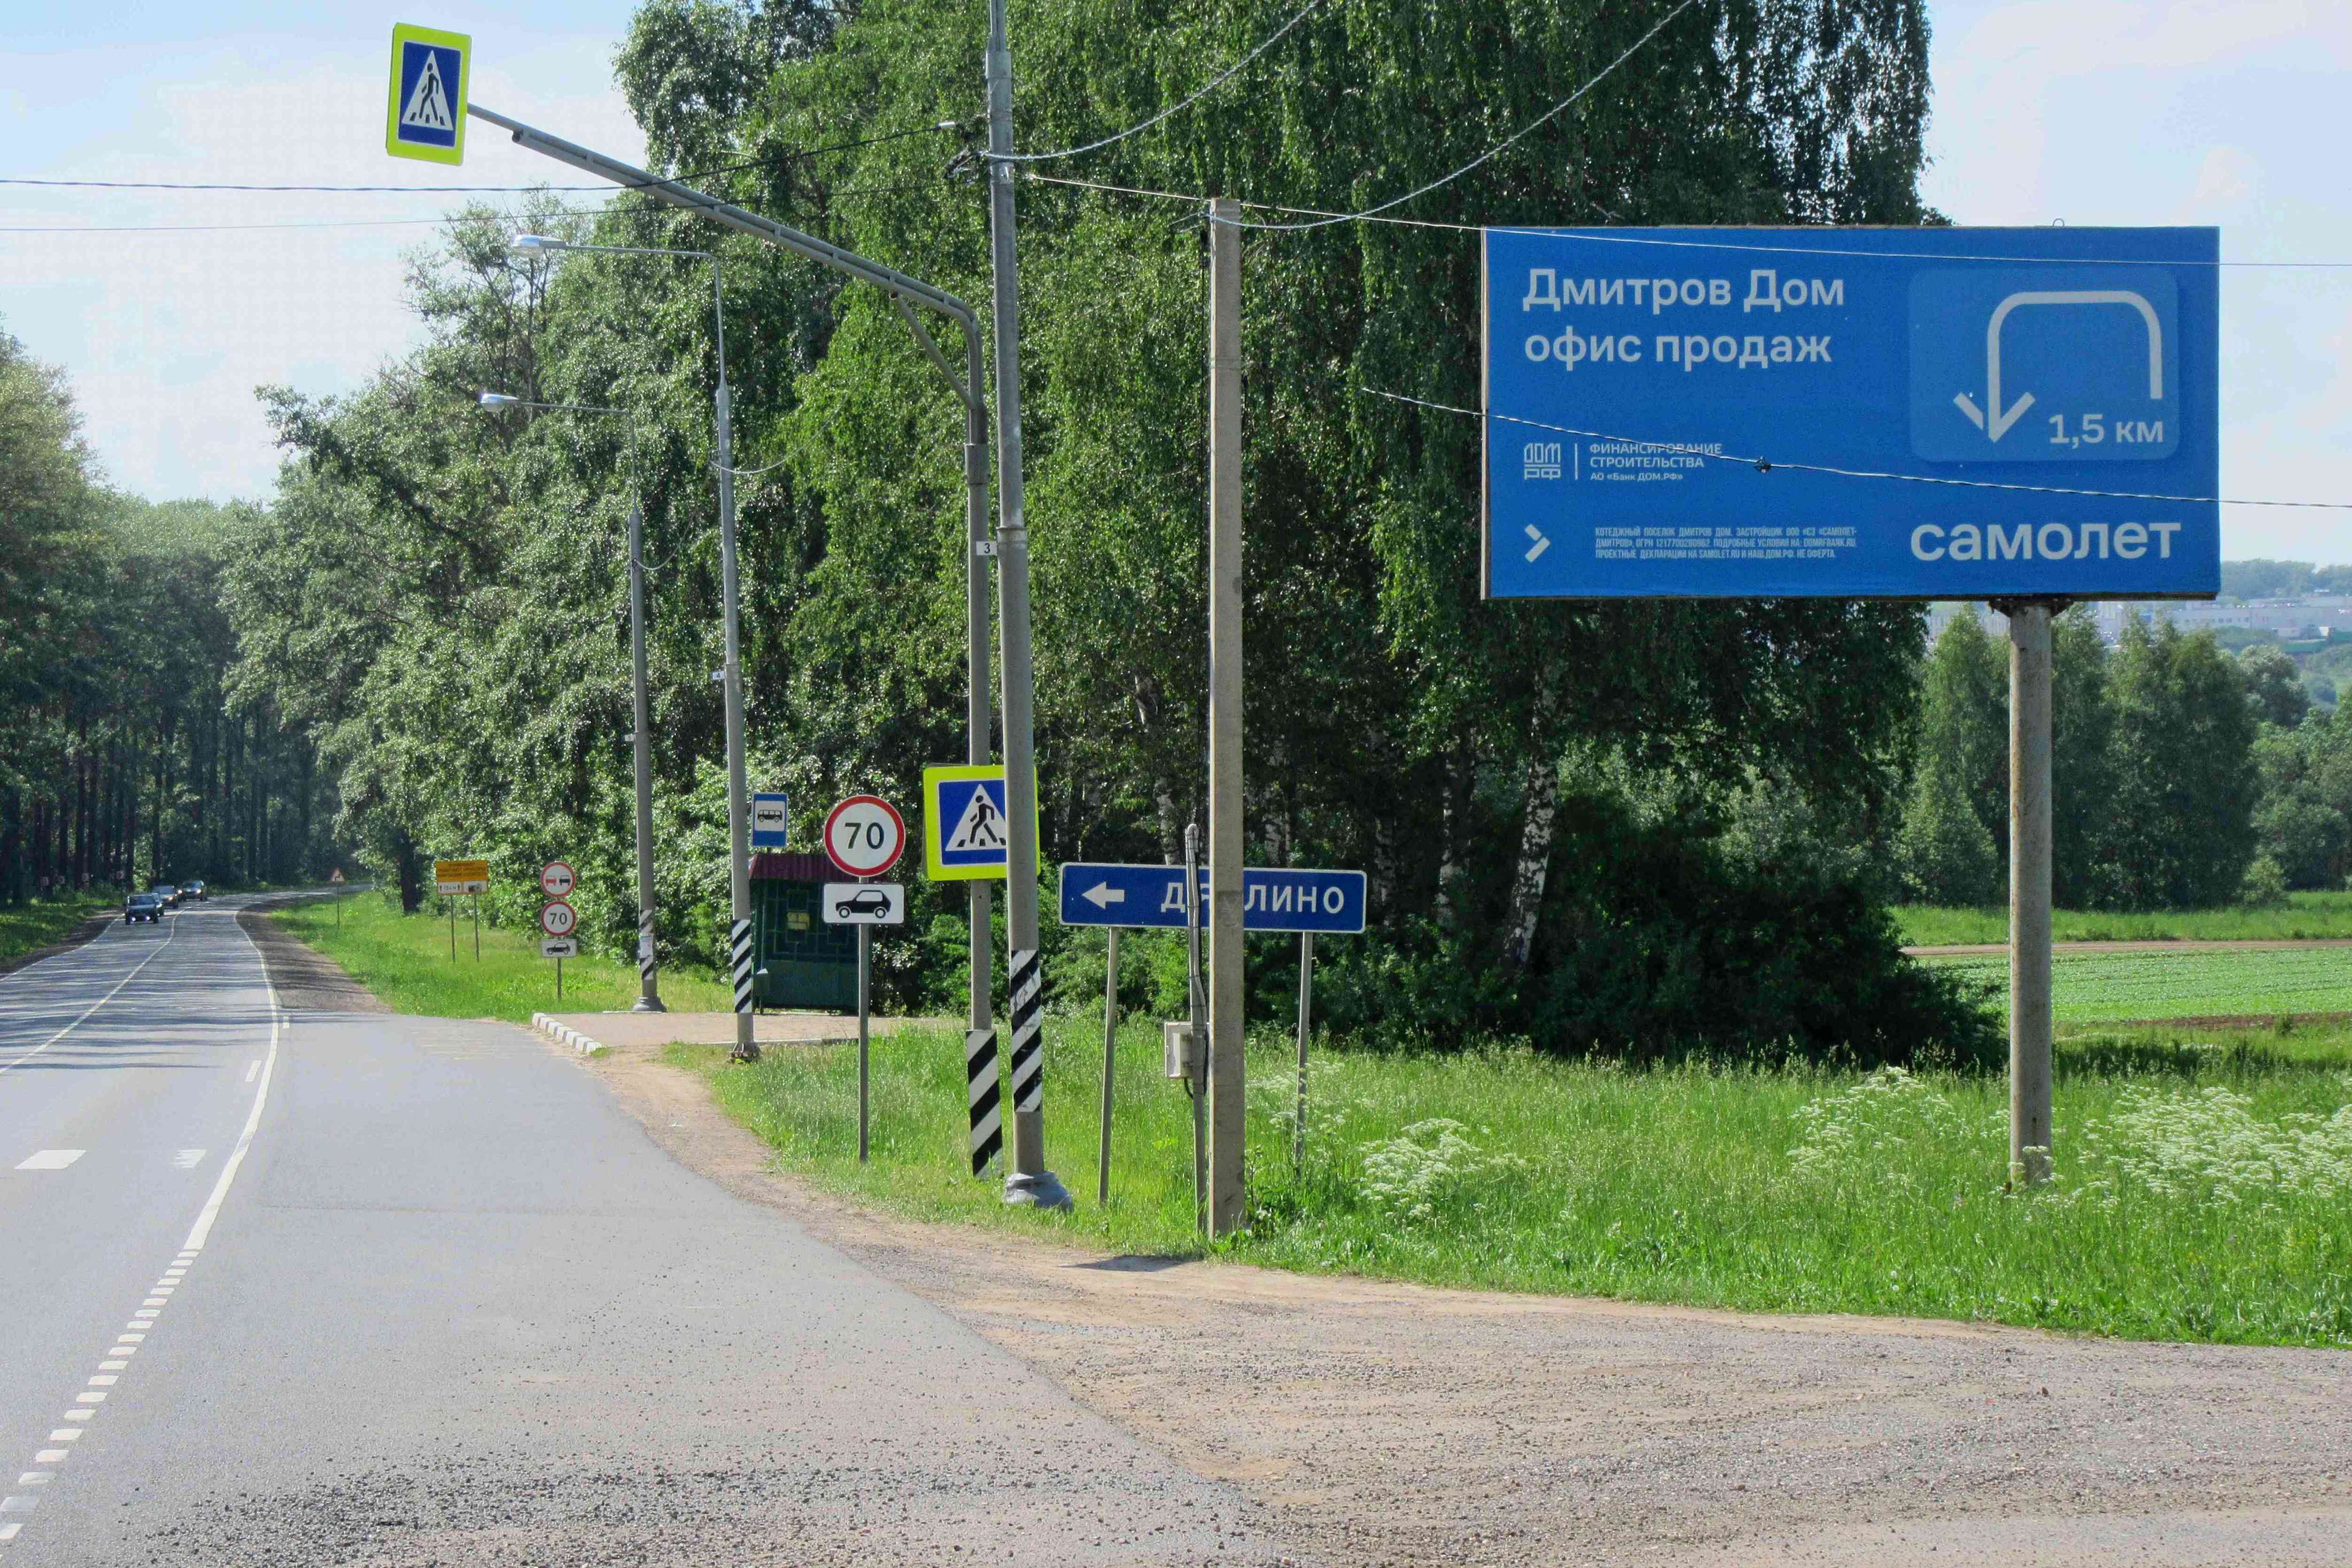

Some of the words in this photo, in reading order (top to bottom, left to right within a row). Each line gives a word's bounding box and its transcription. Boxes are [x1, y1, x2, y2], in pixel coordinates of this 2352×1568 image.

[1522, 268, 1731, 315] Дмитров
[1743, 269, 1844, 312] Дом
[1525, 326, 1641, 371] офис
[1656, 335, 1832, 372] продаж
[2050, 414, 2104, 448] 1,5
[2117, 421, 2163, 442] км
[1590, 443, 1722, 454] ФИНАНСИРОВАНИЕ
[1590, 457, 1704, 467] СТРОИТЕЛЬСТВА
[1607, 473, 1636, 481] «Банк
[984, 543, 991, 554] 3
[1911, 522, 2181, 561] самолет
[844, 822, 885, 850] 70
[1161, 882, 1344, 914] ДЛИНО
[550, 913, 567, 925] 70
